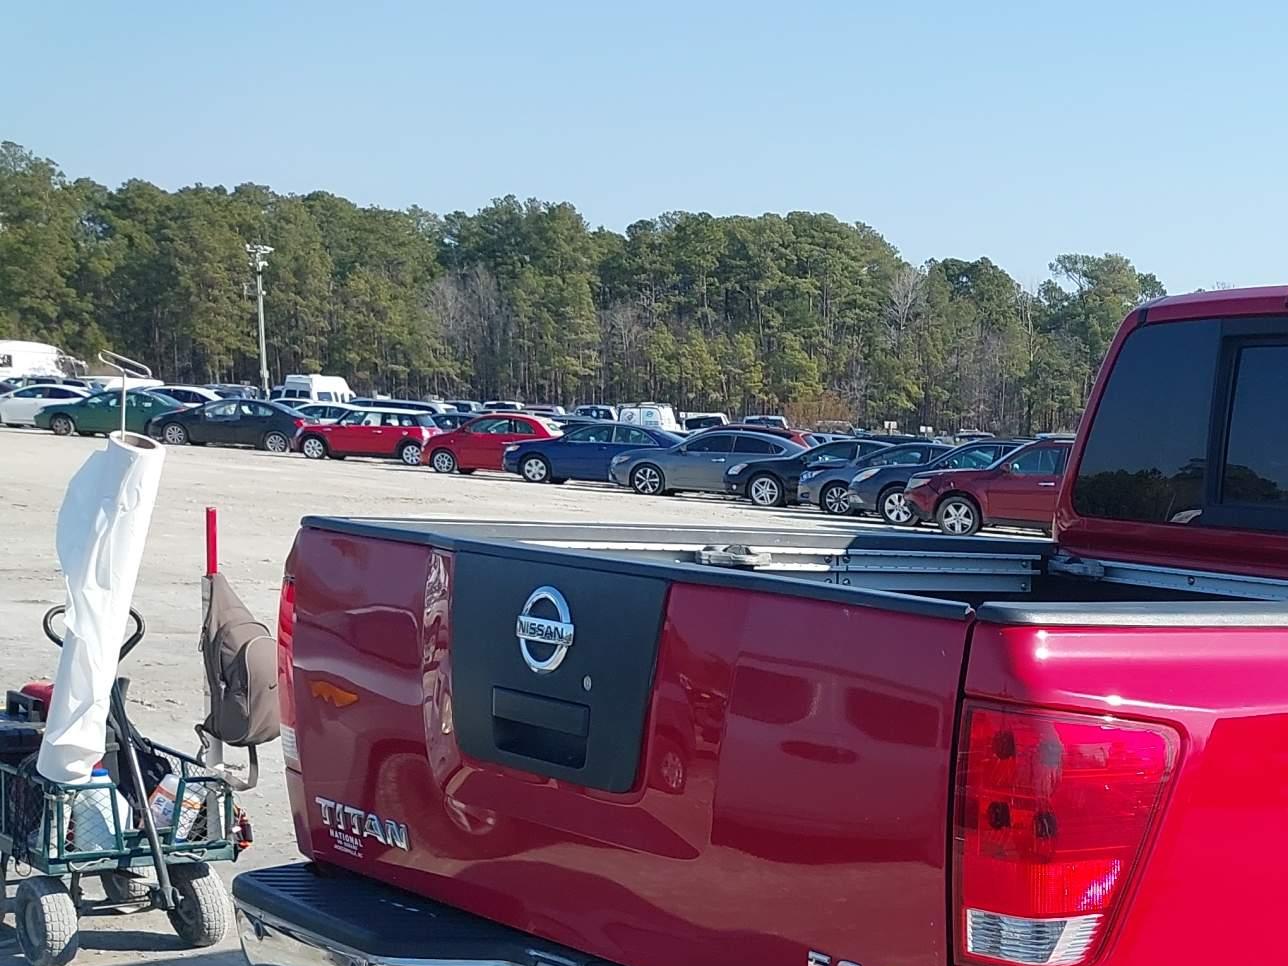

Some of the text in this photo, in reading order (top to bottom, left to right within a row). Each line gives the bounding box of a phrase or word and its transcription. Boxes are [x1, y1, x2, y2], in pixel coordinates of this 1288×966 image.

[518, 620, 565, 641] NISSAN
[315, 796, 410, 852] TITAN
[329, 829, 363, 848] NATIONAL
